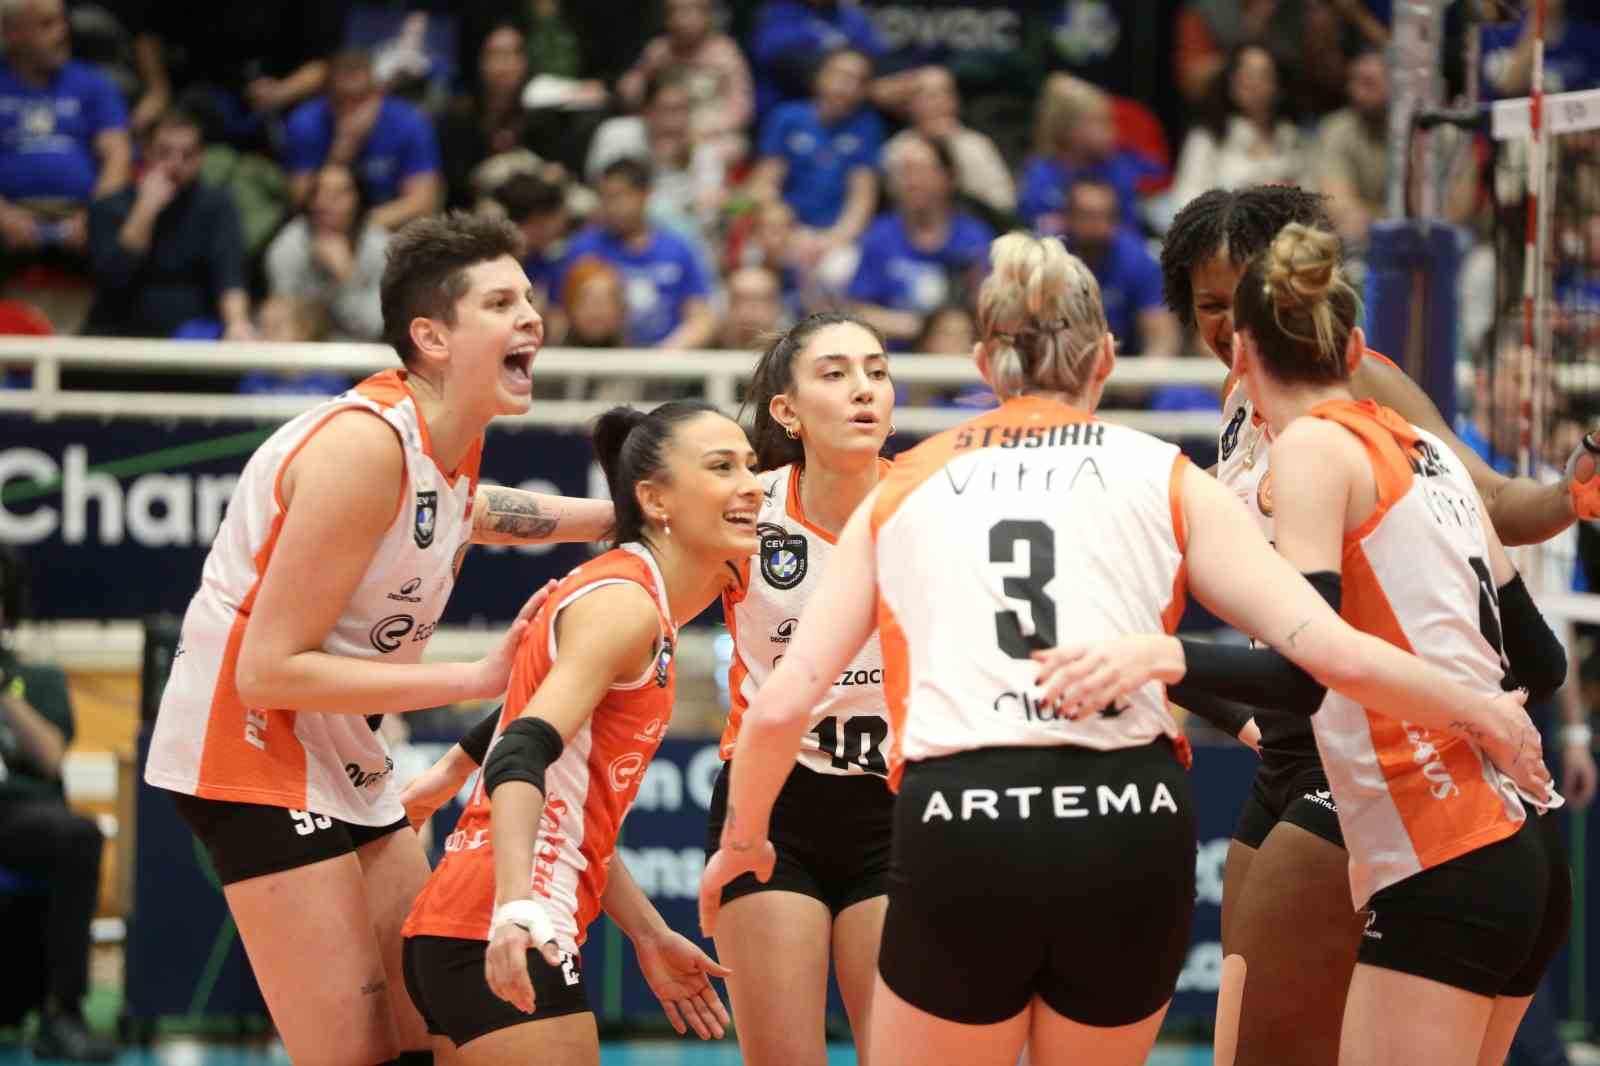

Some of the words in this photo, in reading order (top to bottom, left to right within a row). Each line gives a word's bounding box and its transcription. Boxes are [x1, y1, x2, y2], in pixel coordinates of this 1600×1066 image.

[954, 423, 1105, 450] STYSIAK
[944, 456, 1107, 495] VitrA
[766, 539, 785, 548] CEV
[988, 519, 1058, 660] 3
[810, 715, 890, 775] 10
[922, 782, 1178, 823] ARTEMA
